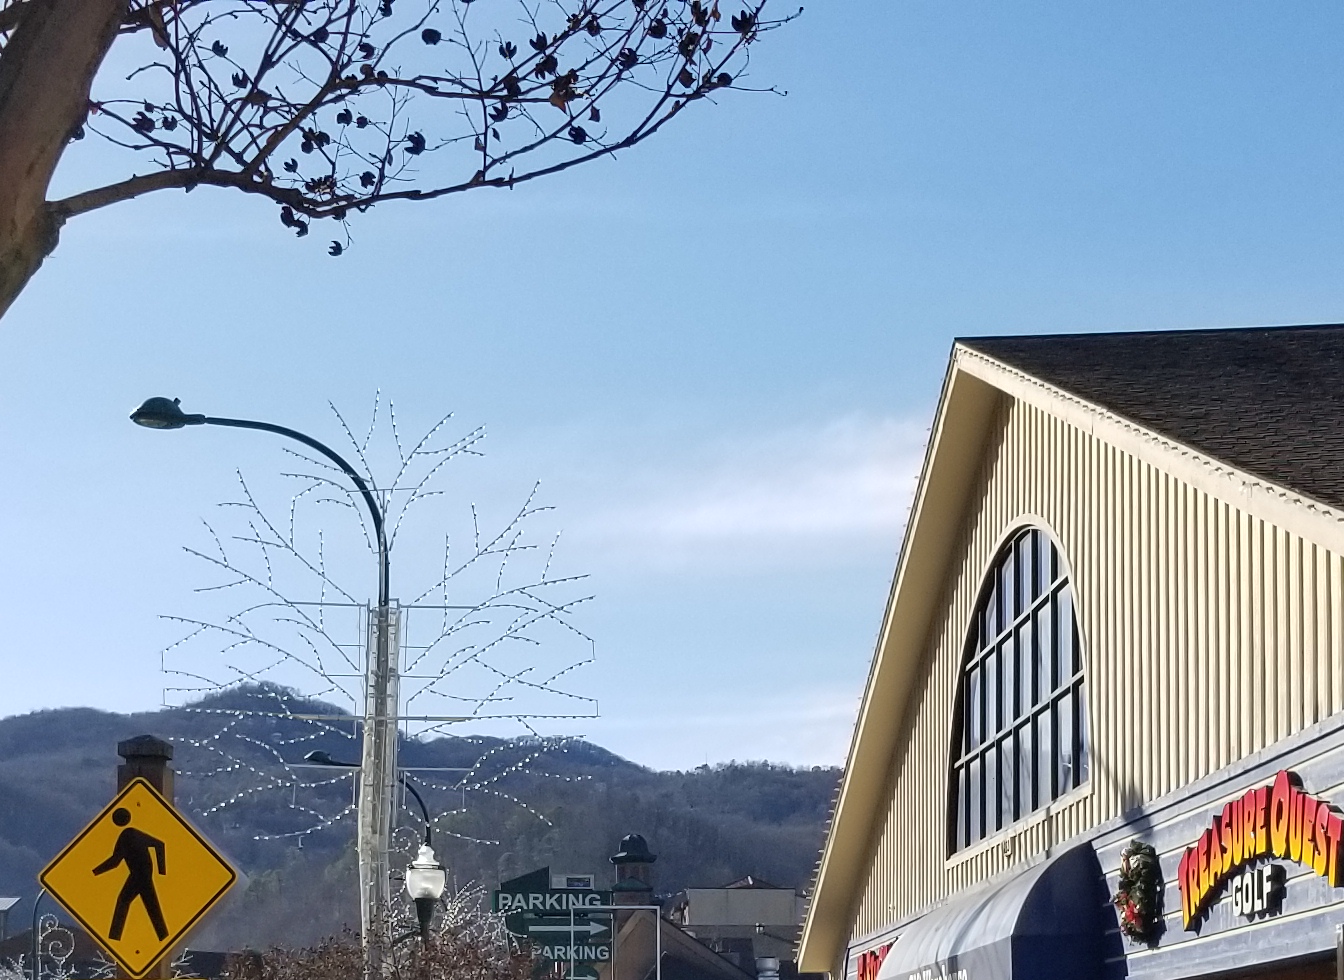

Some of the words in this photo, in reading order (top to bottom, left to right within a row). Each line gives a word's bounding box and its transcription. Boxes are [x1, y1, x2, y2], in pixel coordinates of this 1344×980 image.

[1178, 785, 1271, 931] TREASURE
[498, 892, 602, 911] PARKING
[1232, 864, 1273, 917] GOLF
[532, 945, 610, 960] PARKING
